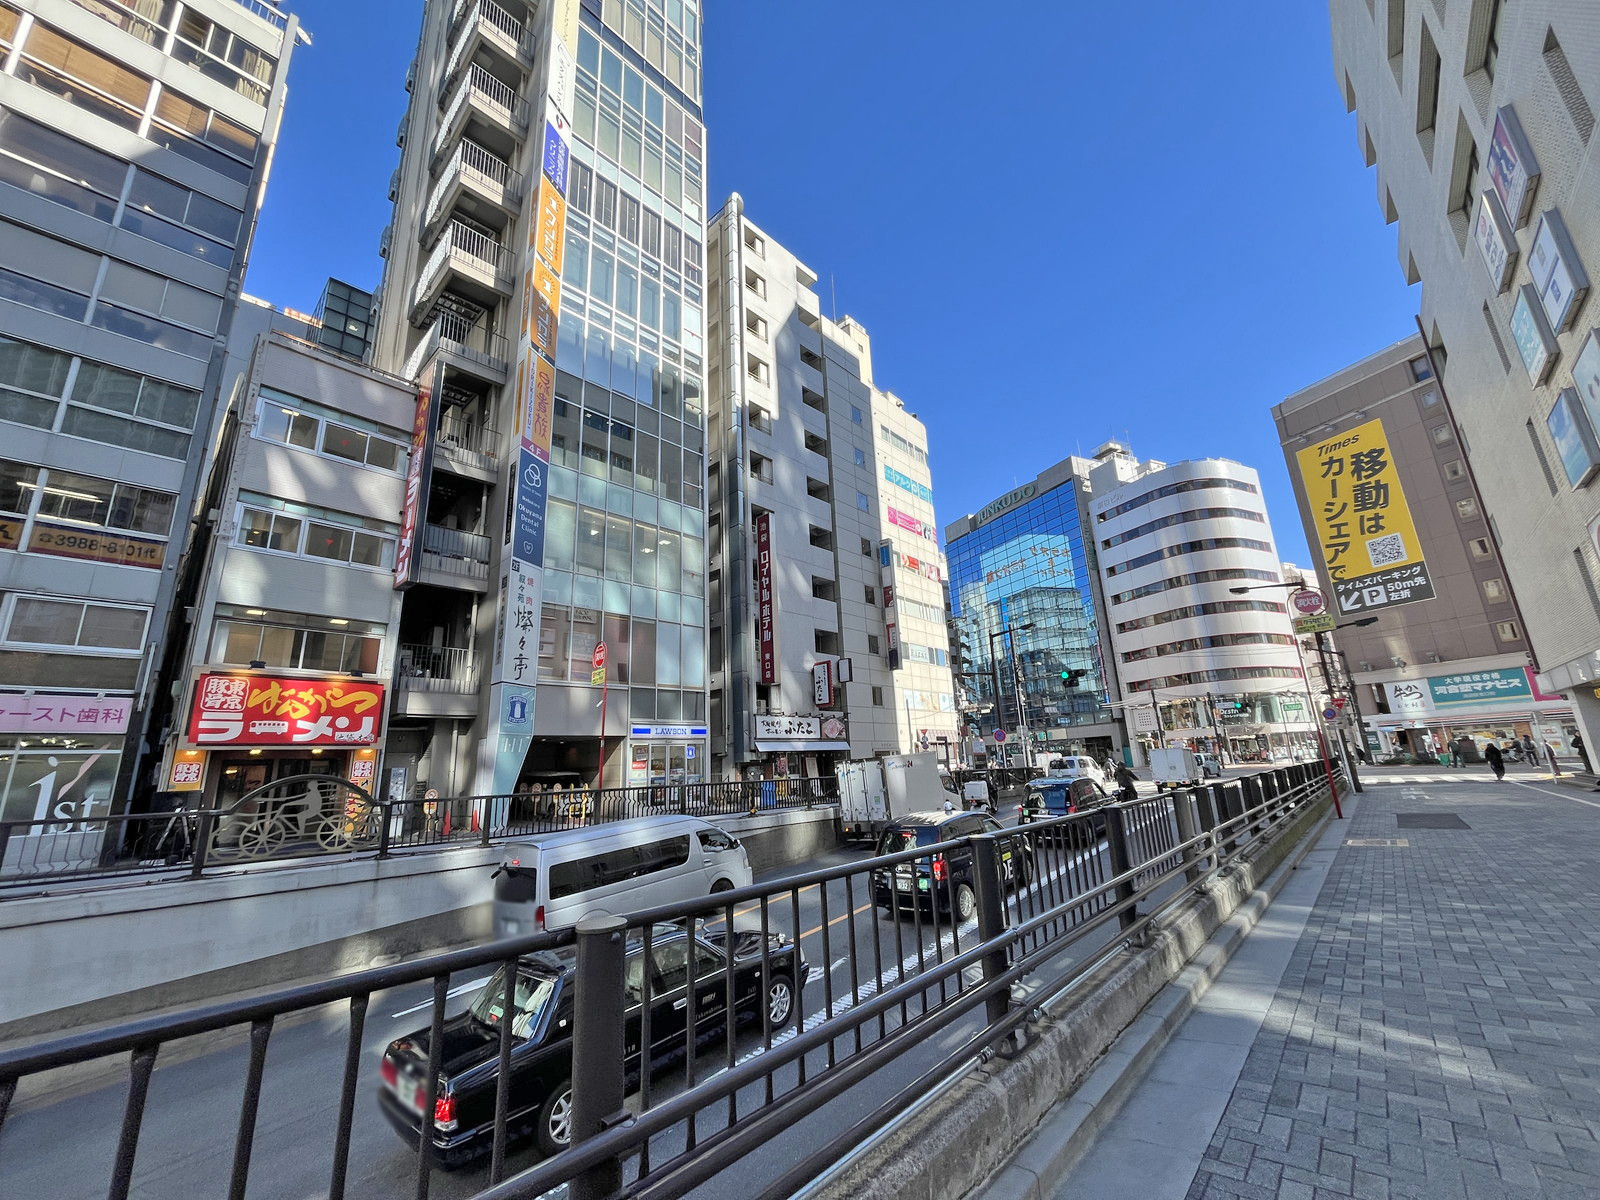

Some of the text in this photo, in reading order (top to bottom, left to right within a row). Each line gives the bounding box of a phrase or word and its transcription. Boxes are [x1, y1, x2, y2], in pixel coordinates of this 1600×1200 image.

[529, 445, 541, 455] 4F
[1318, 434, 1360, 457] Times
[1351, 447, 1390, 535] 移動は
[518, 503, 543, 520] Okuyama
[978, 485, 1035, 524] JUNKUDO
[520, 514, 540, 527] Dental
[1321, 456, 1351, 580] カーシェアで
[521, 524, 538, 537] Clinic
[759, 521, 767, 542] 池袋
[512, 561, 519, 570] 2F
[1337, 566, 1421, 592] タイムズパーキング
[1387, 576, 1426, 592] 50m先
[525, 577, 535, 606] 焼肉
[760, 550, 771, 642] ロイヤルホテル
[1389, 589, 1411, 601] 左折
[1296, 596, 1321, 608] 消火栓
[1434, 678, 1522, 695] 河合塾マナビス
[198, 712, 373, 742] ラーメン
